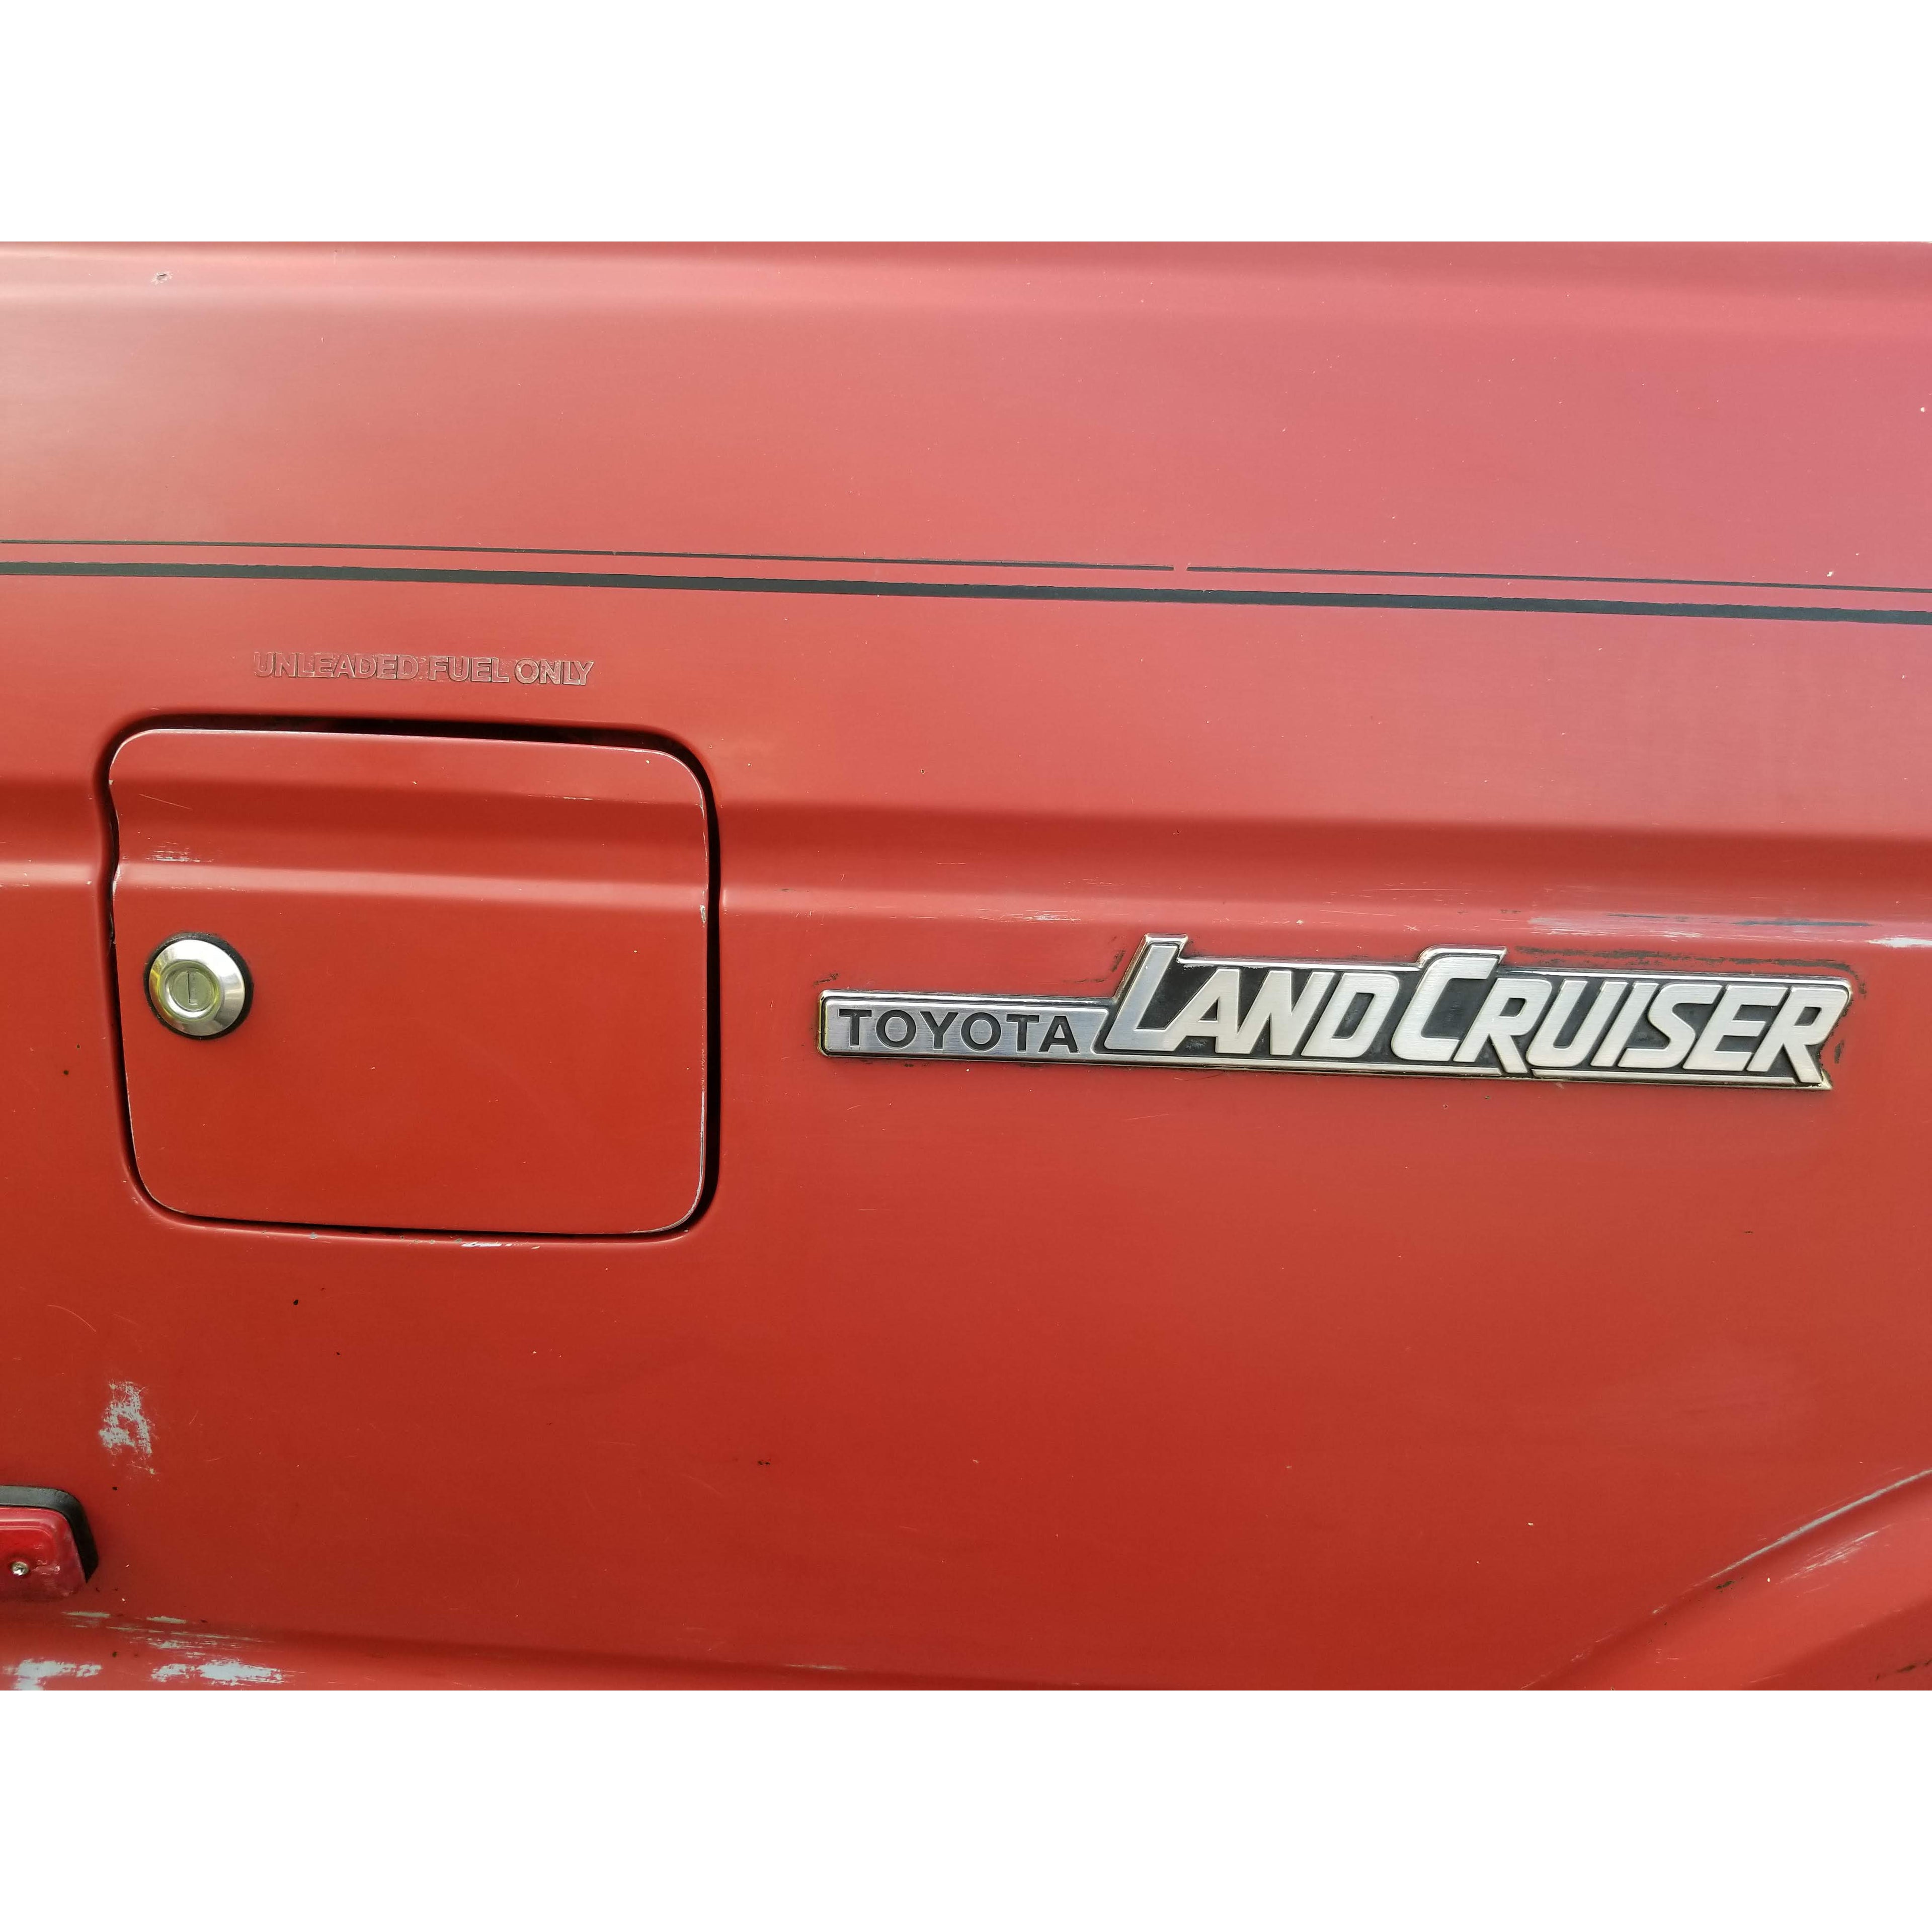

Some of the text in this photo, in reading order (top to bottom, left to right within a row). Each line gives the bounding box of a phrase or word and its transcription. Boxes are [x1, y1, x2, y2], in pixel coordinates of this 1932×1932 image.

[254, 652, 594, 685] UNLEADED FUEL ONLY
[838, 1009, 1080, 1054] TOYOTA
